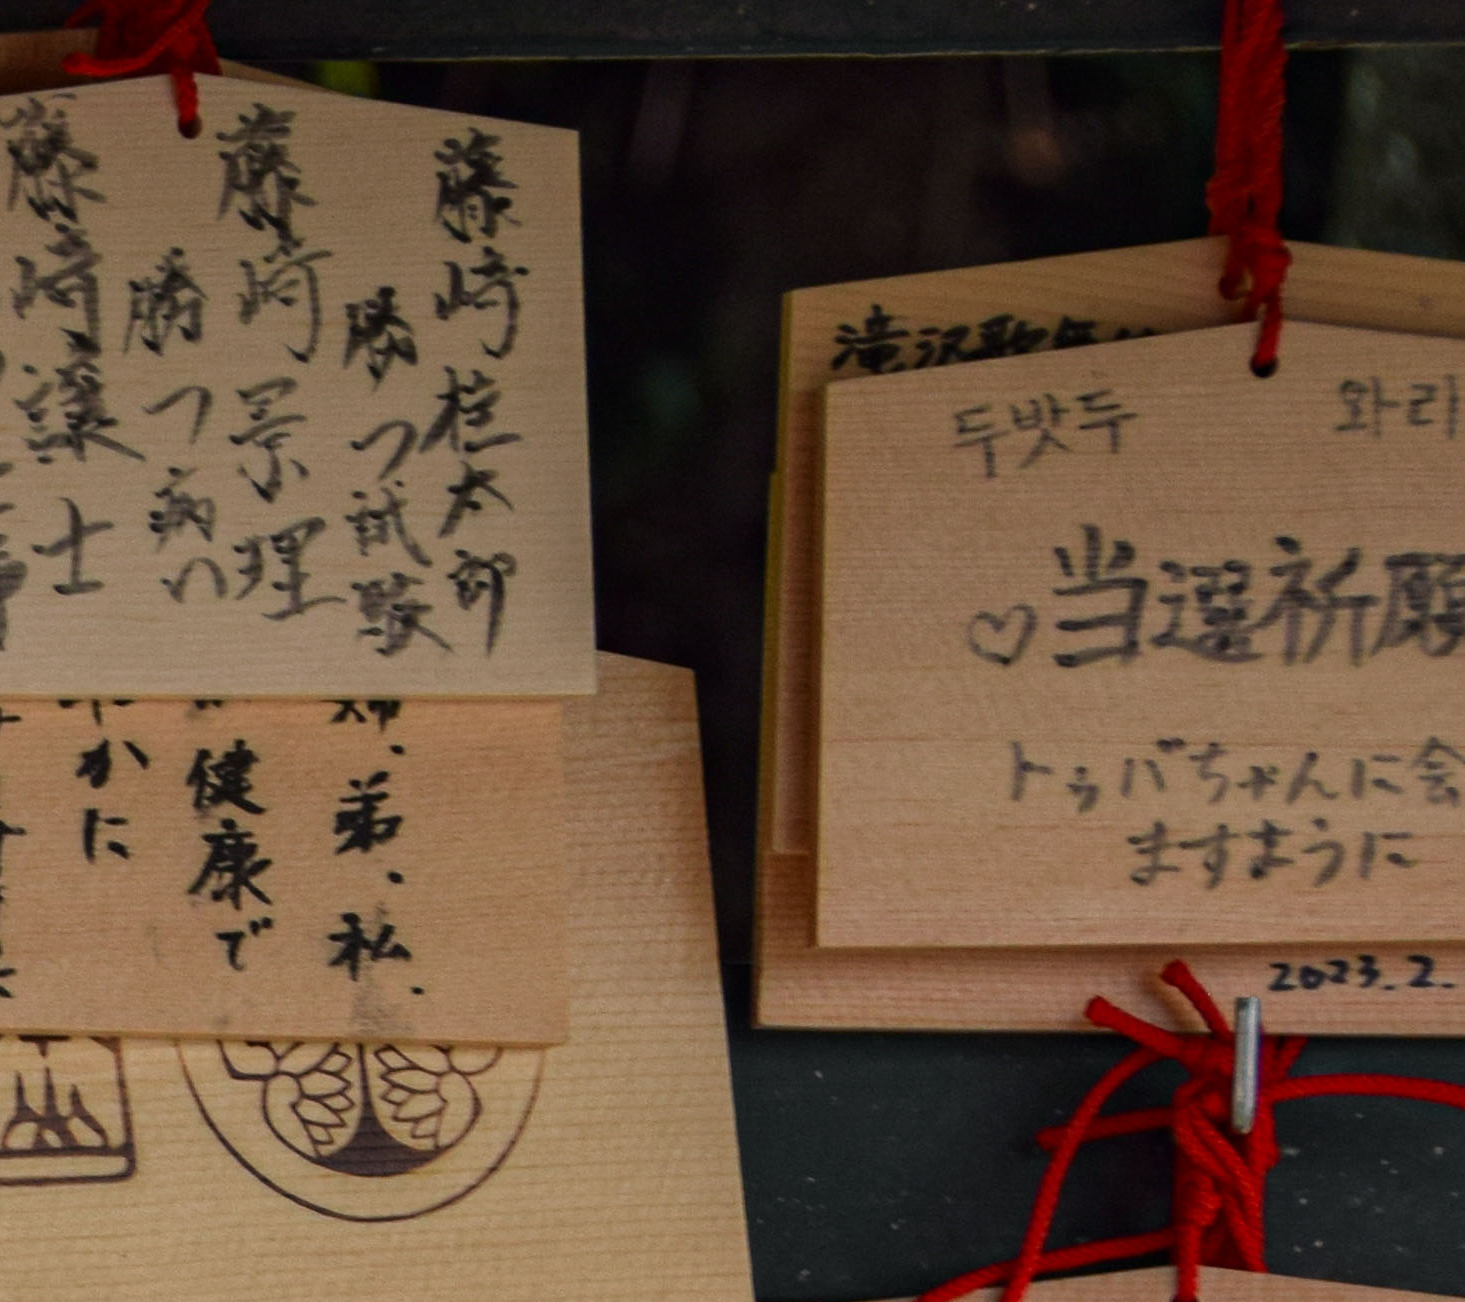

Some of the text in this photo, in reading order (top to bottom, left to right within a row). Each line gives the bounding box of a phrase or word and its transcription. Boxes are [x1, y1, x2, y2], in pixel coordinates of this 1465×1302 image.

[186, 700, 273, 971] 健康で
[1127, 819, 1417, 887] ますように
